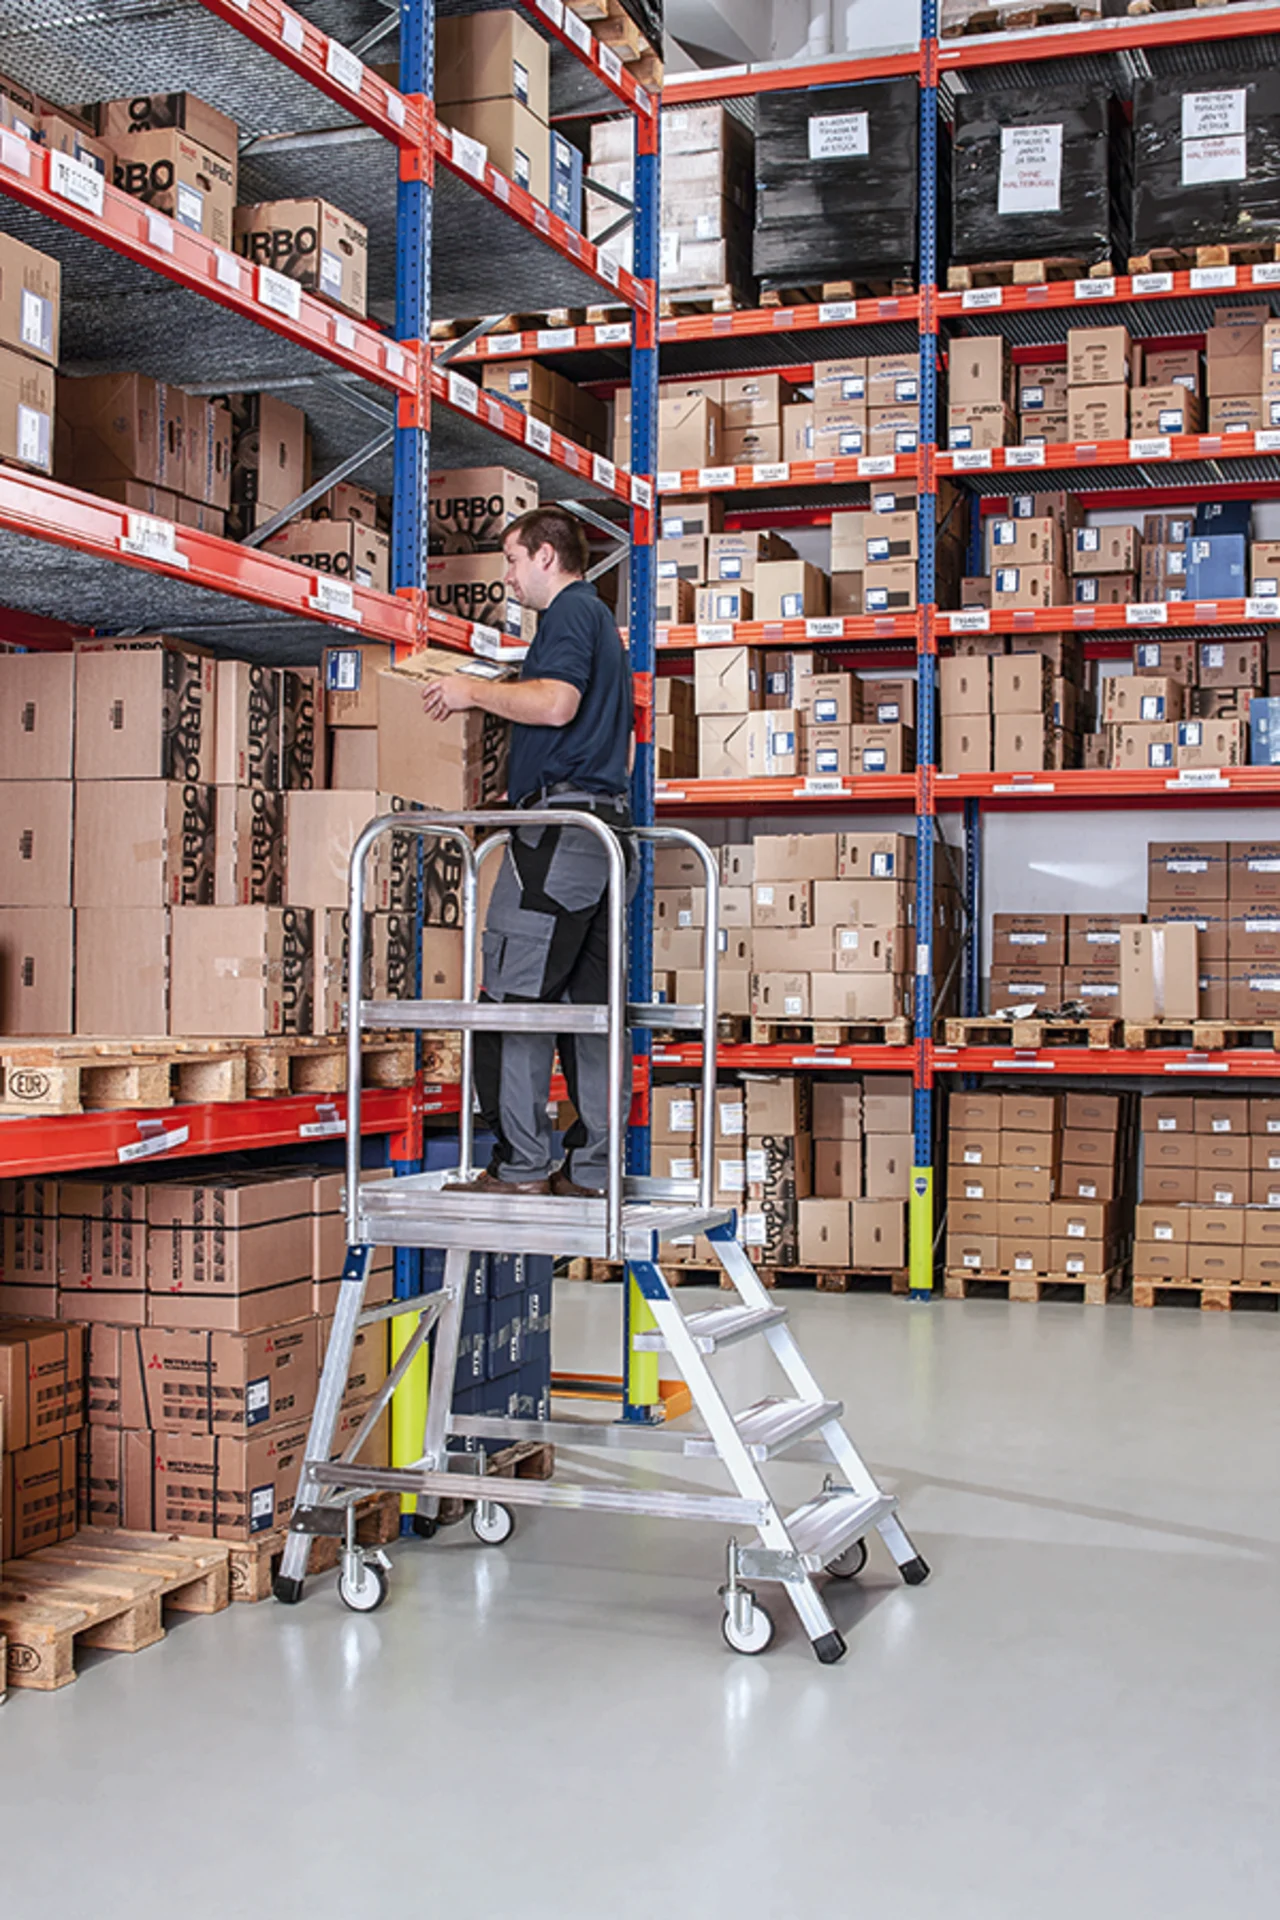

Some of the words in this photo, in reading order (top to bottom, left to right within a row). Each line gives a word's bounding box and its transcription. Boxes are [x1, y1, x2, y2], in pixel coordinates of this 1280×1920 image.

[180, 654, 202, 783] TURBO
[248, 667, 266, 788] TURBO
[182, 784, 199, 905] TURBO
[250, 790, 267, 905] TURBO
[282, 908, 298, 1029] TURBO
[17, 1074, 41, 1093] EUR
[163, 1358, 217, 1368] MITSUBISI
